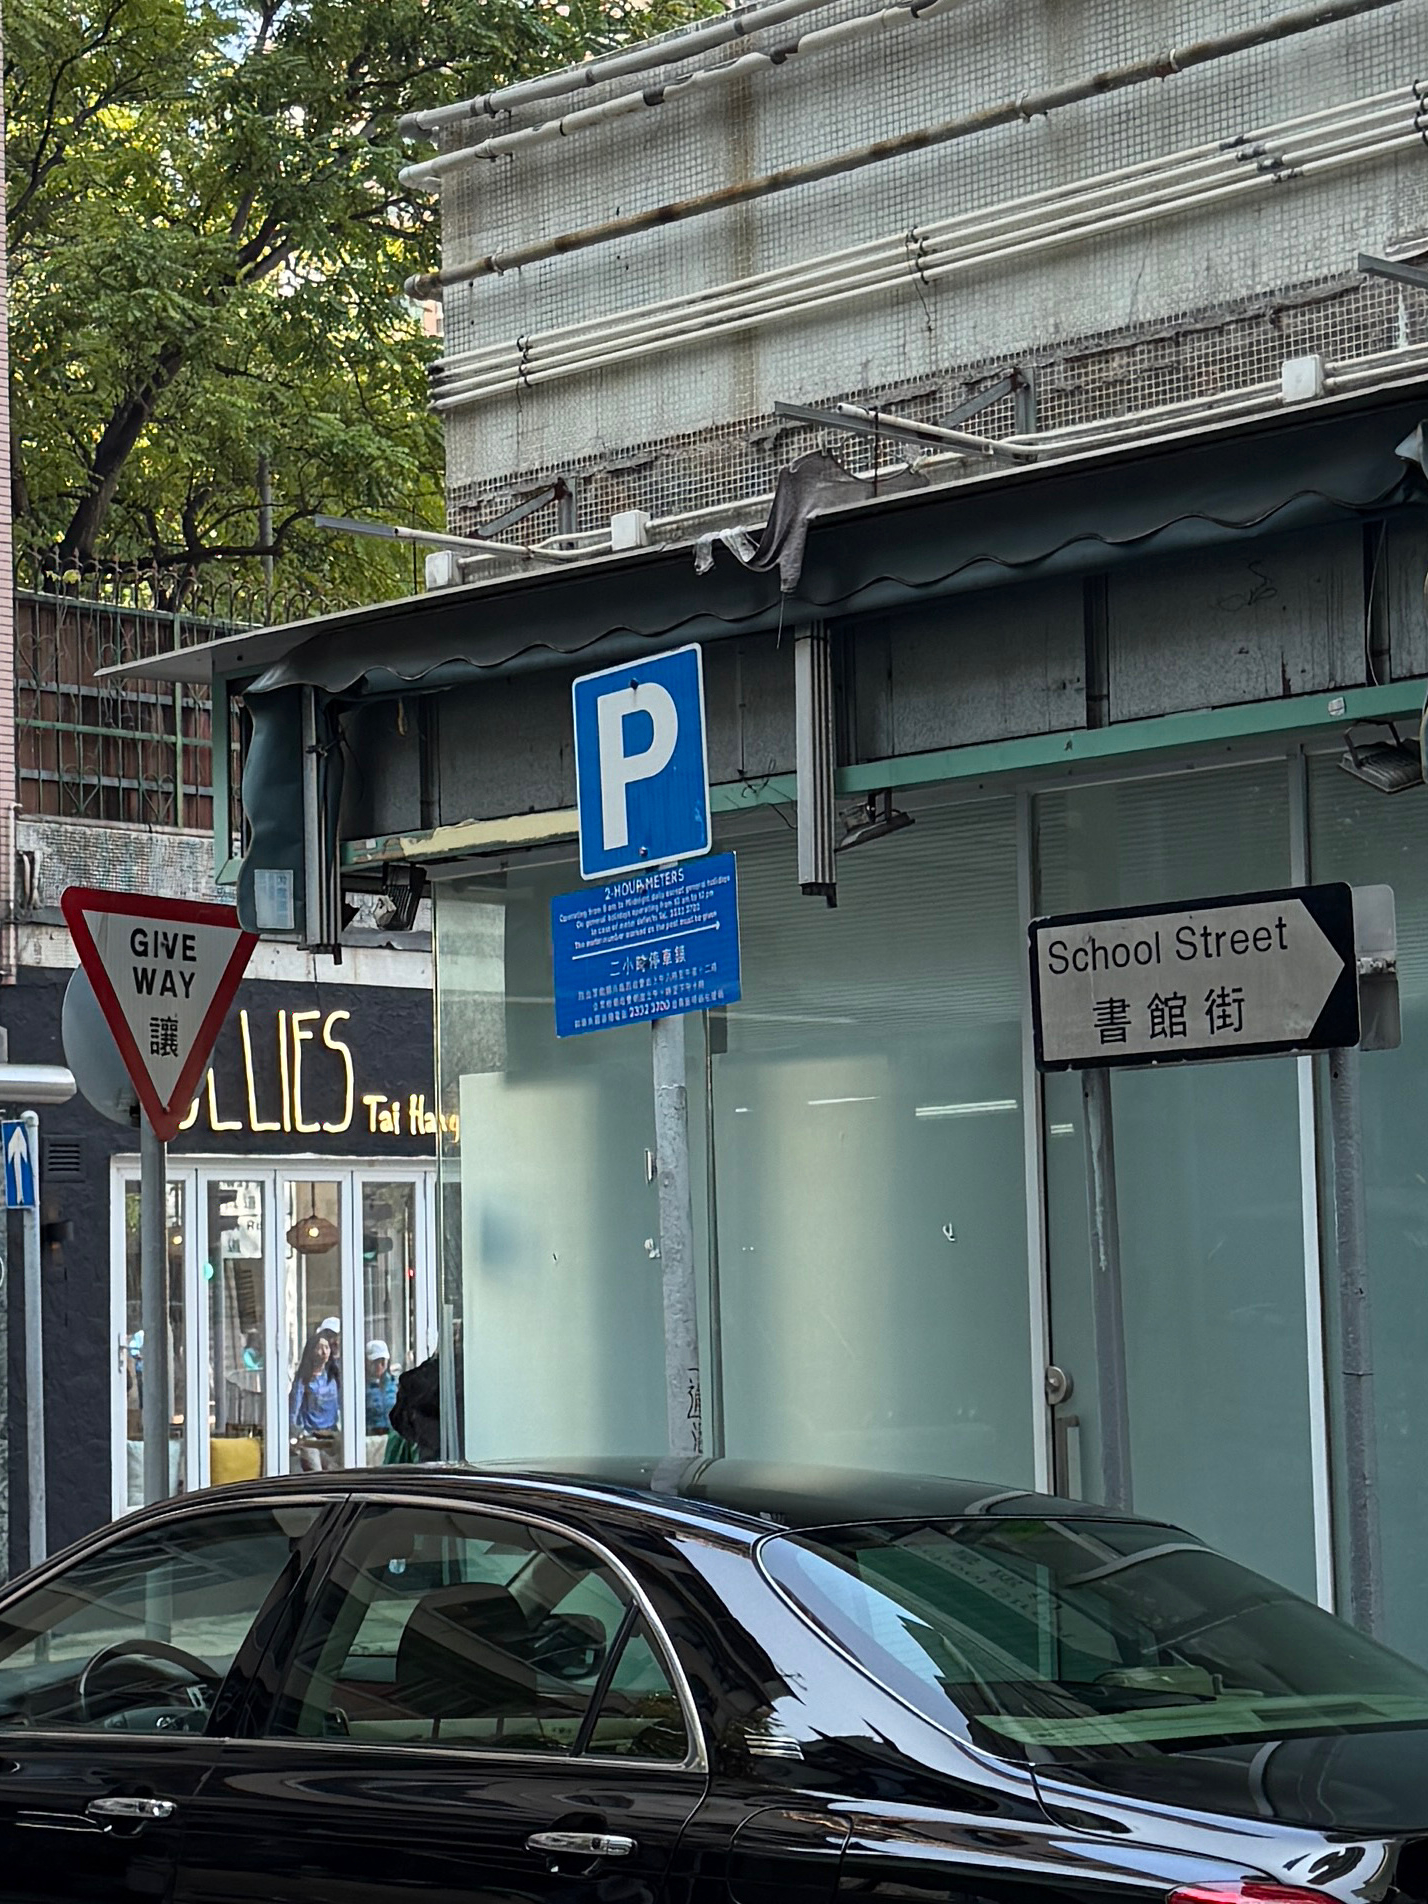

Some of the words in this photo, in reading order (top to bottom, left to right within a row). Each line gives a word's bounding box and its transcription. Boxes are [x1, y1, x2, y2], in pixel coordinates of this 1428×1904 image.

[597, 681, 678, 850] P
[604, 879, 644, 901] 2-HOUR
[645, 867, 685, 890] METERS
[129, 927, 198, 963] GIVE
[1048, 931, 1161, 975] School
[1175, 916, 1288, 961] Street
[132, 966, 196, 1000] WAY
[149, 1016, 179, 1058] 讓
[1092, 986, 1246, 1045] 書館街
[178, 1008, 356, 1135] LLIES
[362, 1094, 401, 1136] Tai
[408, 1093, 460, 1143] Hang
